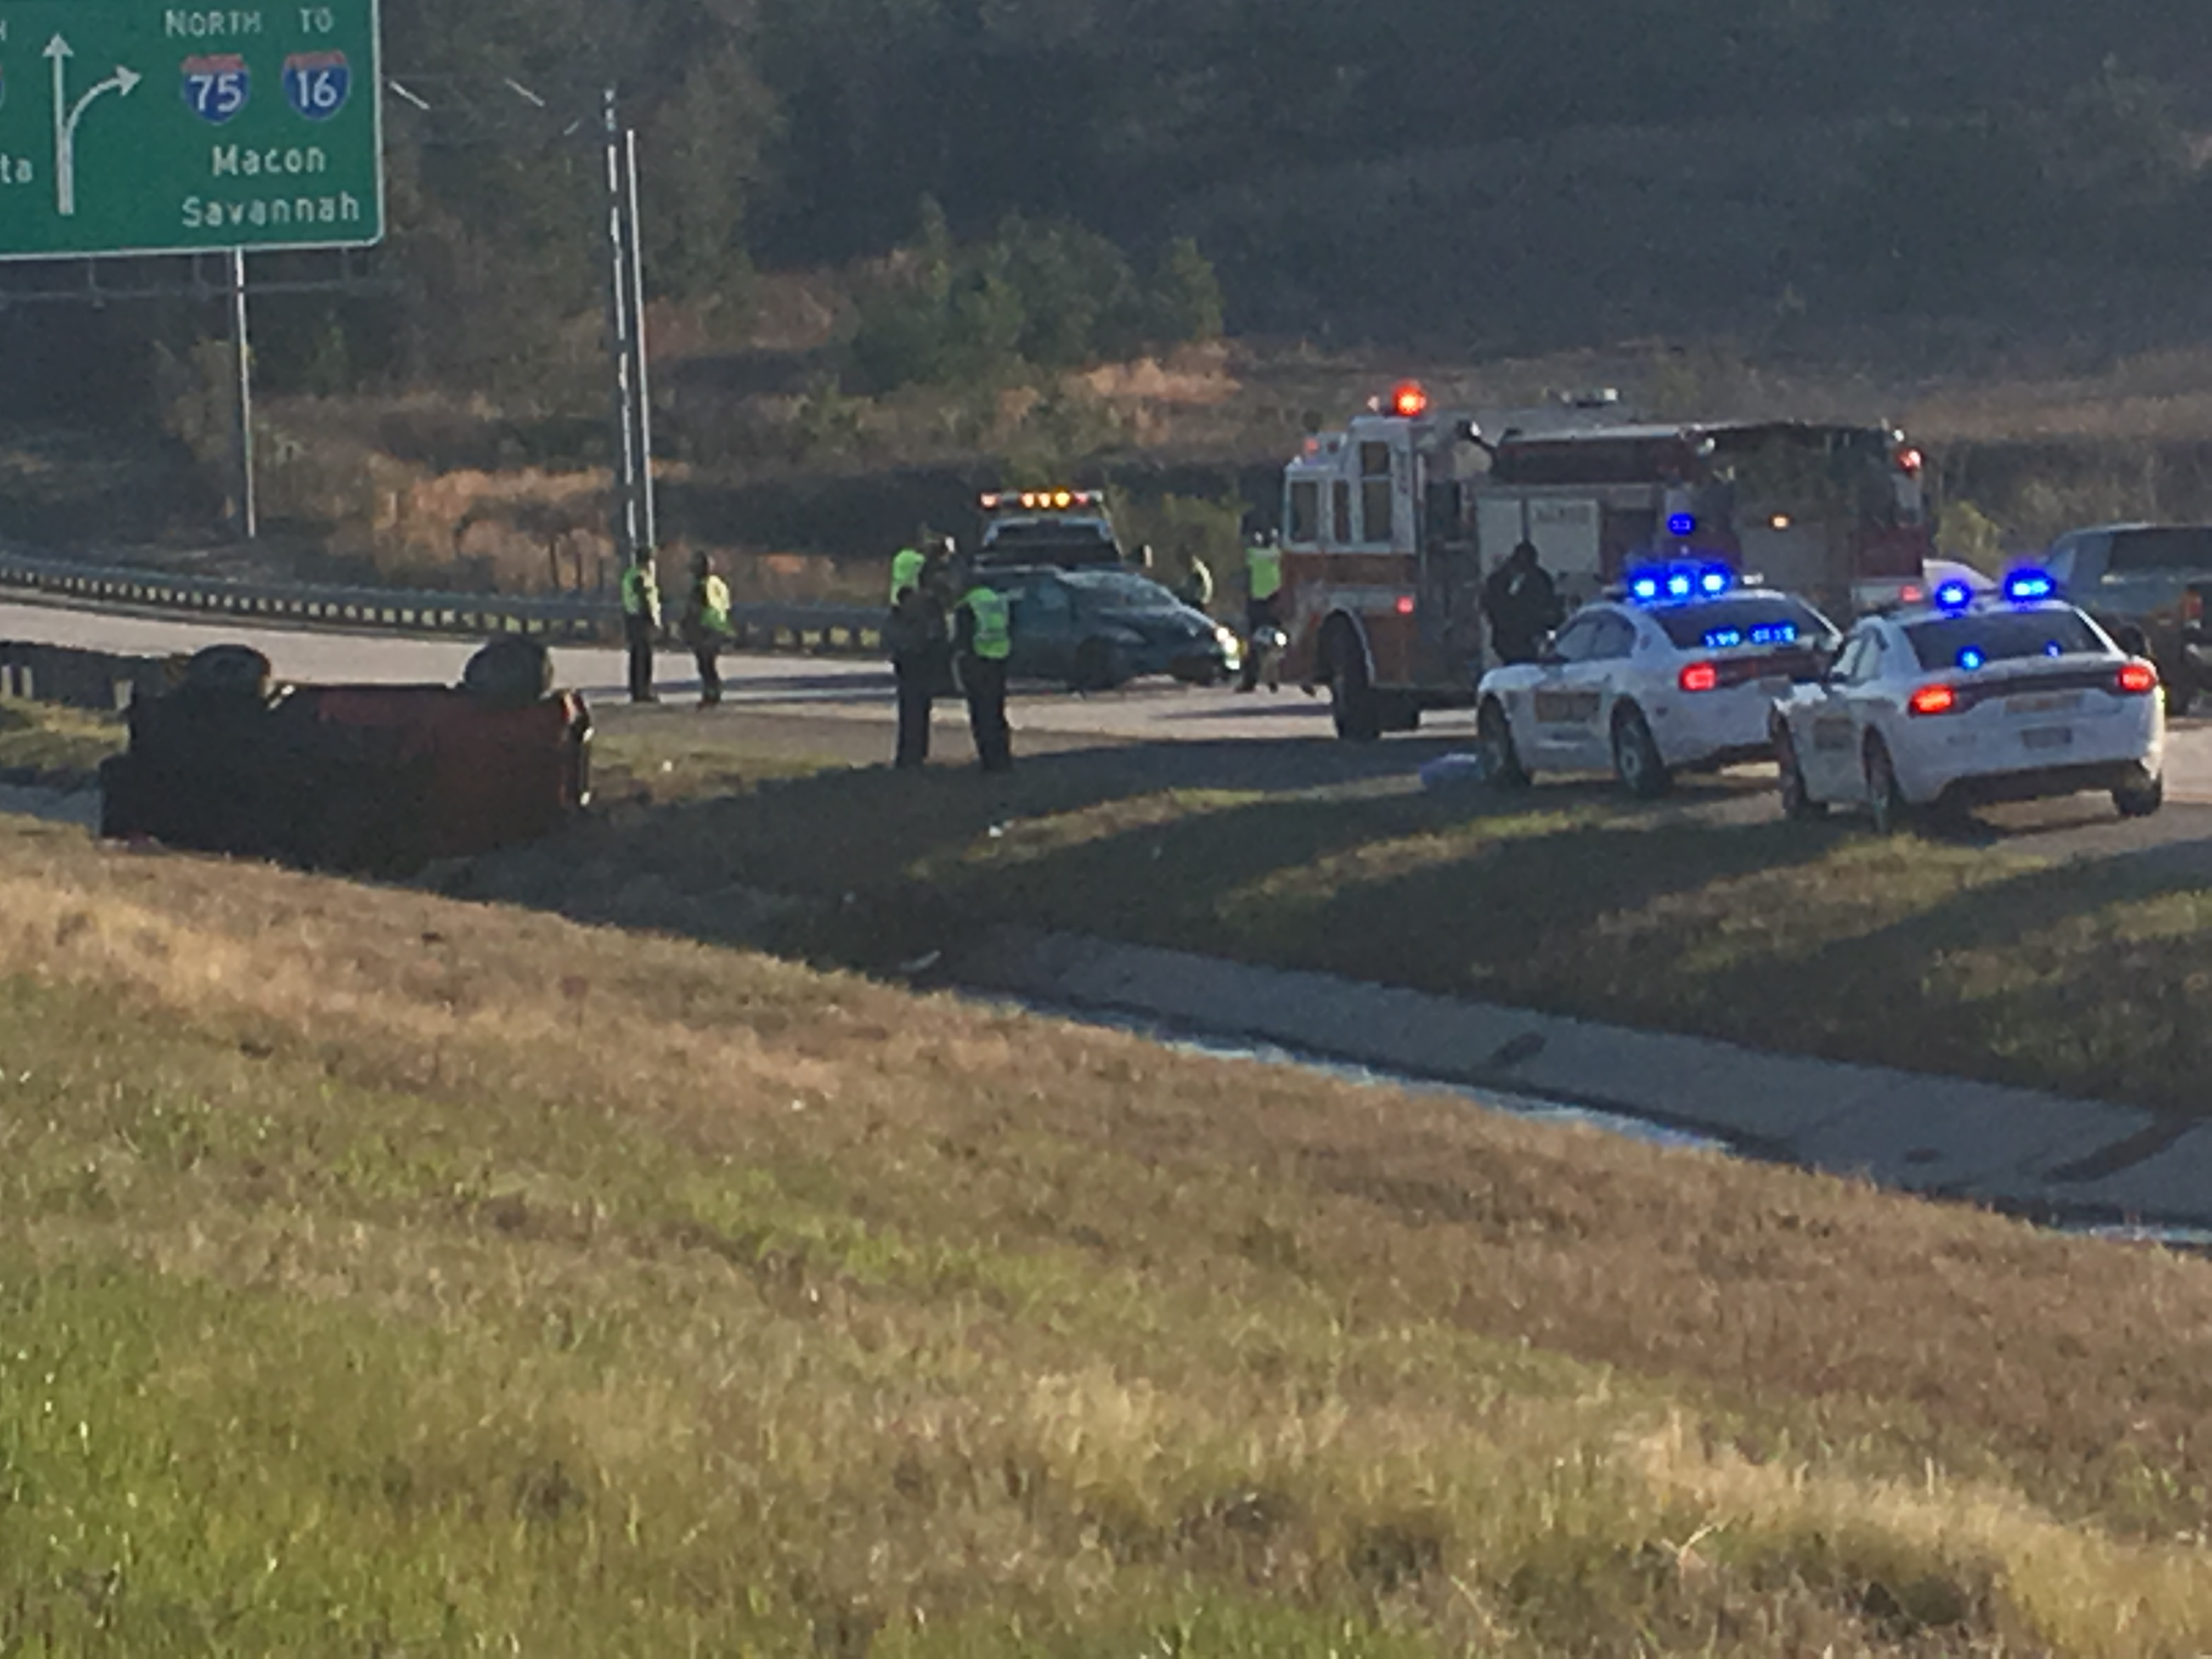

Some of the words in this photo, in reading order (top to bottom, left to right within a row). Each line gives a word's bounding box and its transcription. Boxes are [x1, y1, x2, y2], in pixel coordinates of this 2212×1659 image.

[165, 10, 262, 36] NORTH
[300, 8, 334, 32] TO
[190, 75, 242, 112] 75
[297, 71, 336, 108] 16
[212, 145, 325, 177] Macon
[182, 192, 359, 227] Savannah
